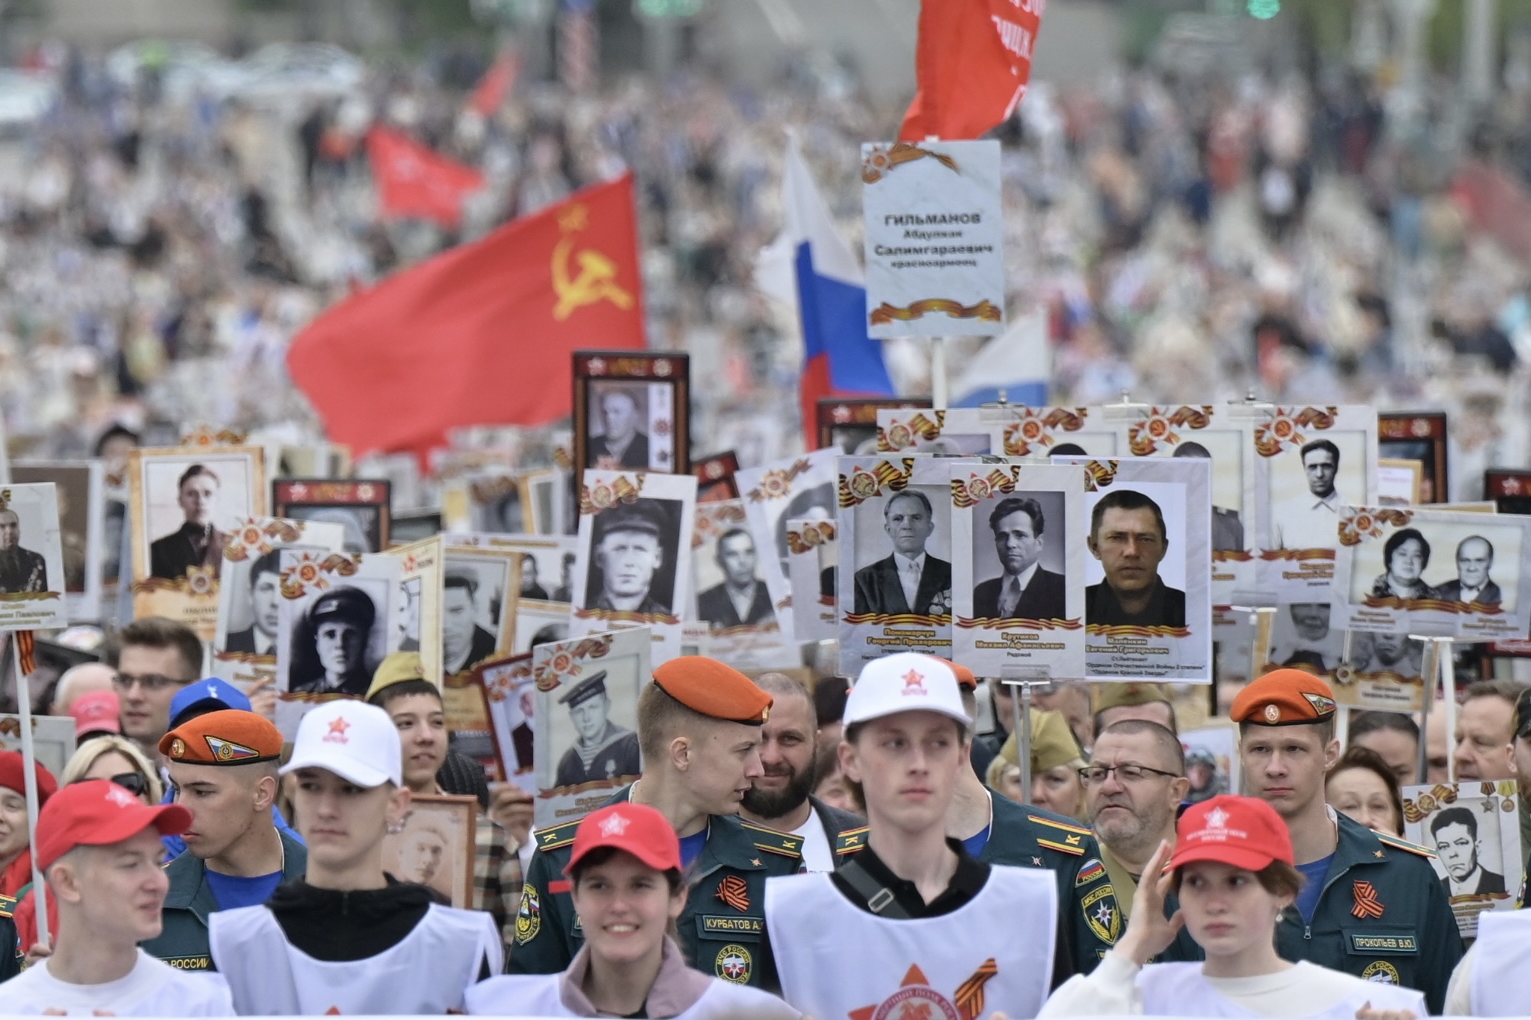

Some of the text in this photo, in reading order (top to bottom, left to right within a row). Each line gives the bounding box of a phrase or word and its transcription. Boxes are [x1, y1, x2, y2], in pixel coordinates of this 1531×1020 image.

[884, 213, 981, 226] ГИЛЬМАНОВ
[874, 244, 993, 256] Салимгараевич
[884, 628, 936, 638] Пономарчук
[1001, 632, 1039, 641] Крутиков
[867, 636, 952, 647] Георгий Прохорович
[975, 640, 1066, 650] Михаил Афанасьевич
[1085, 645, 1170, 655] Евгений Григорьевич
[706, 918, 750, 930] КУРБАТОВ
[1356, 938, 1397, 948] ПРОКОПЬЕВ
